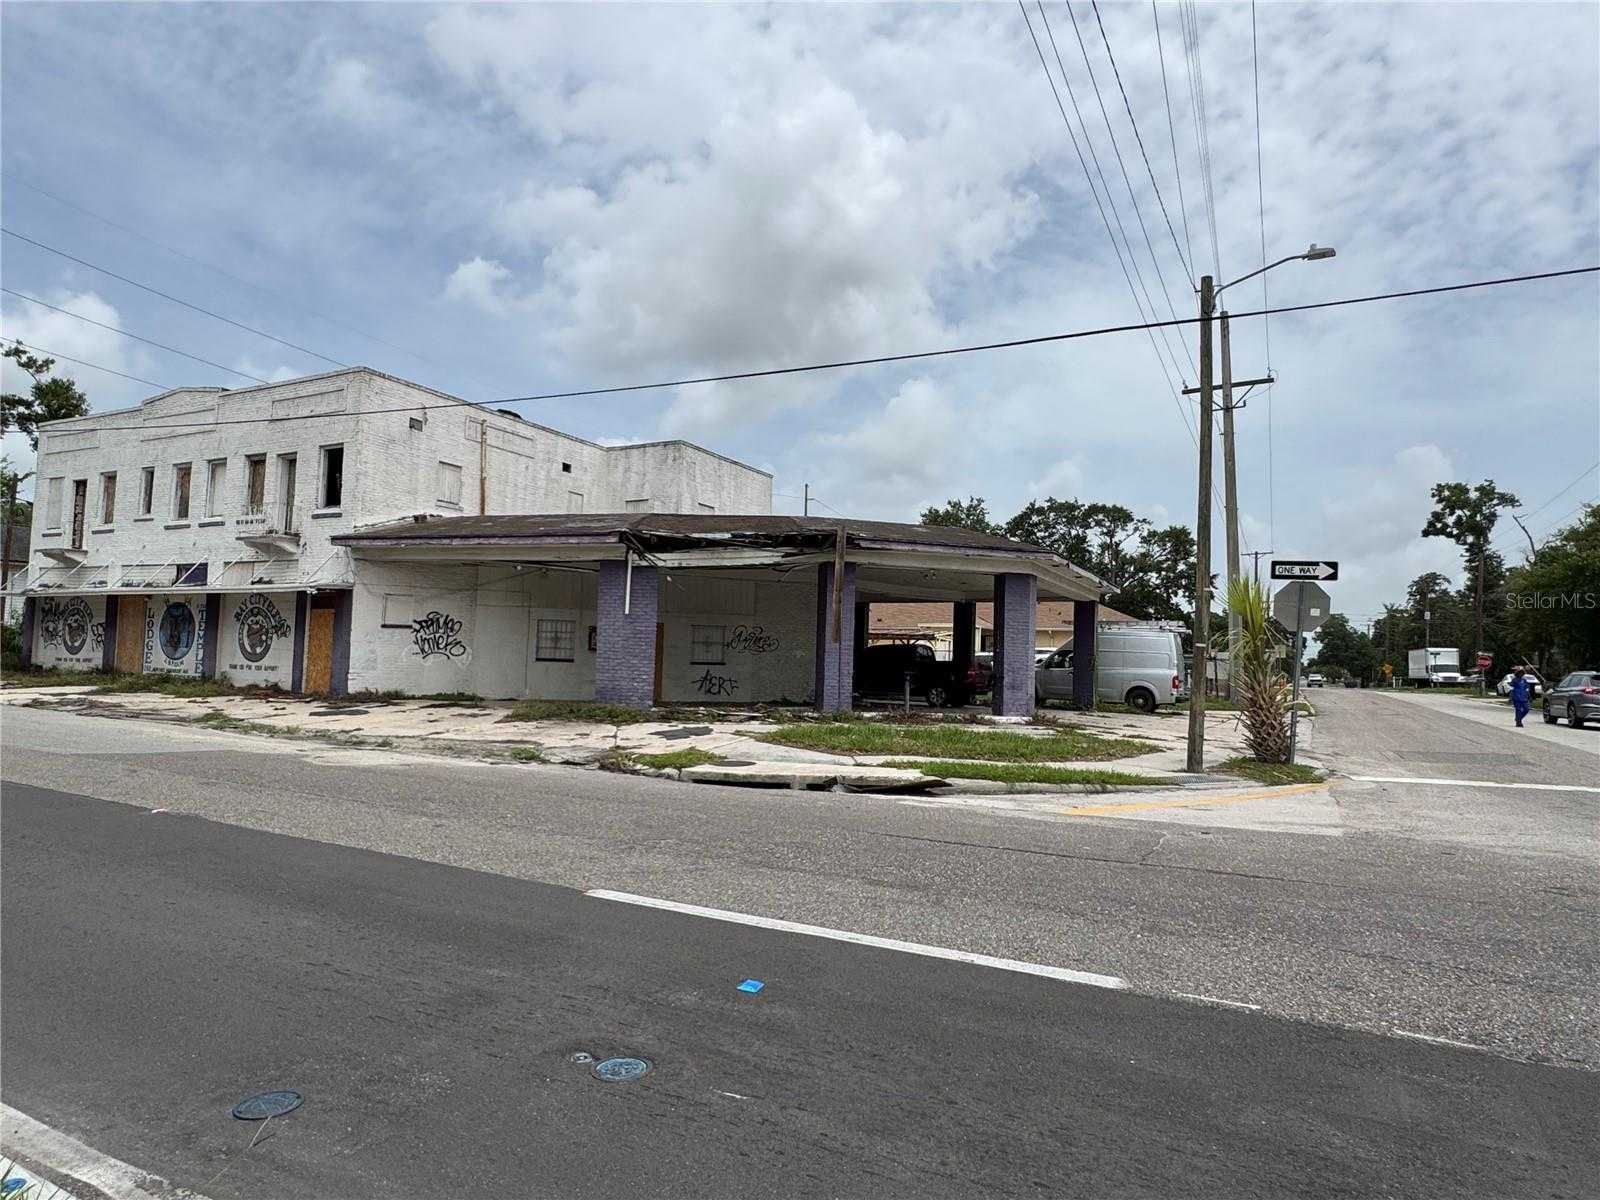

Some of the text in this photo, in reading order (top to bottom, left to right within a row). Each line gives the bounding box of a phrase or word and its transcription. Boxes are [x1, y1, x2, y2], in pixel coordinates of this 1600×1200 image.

[1277, 566, 1318, 575] ONE WAY
[145, 607, 155, 664] LODGE
[195, 609, 208, 674] TEMPLE
